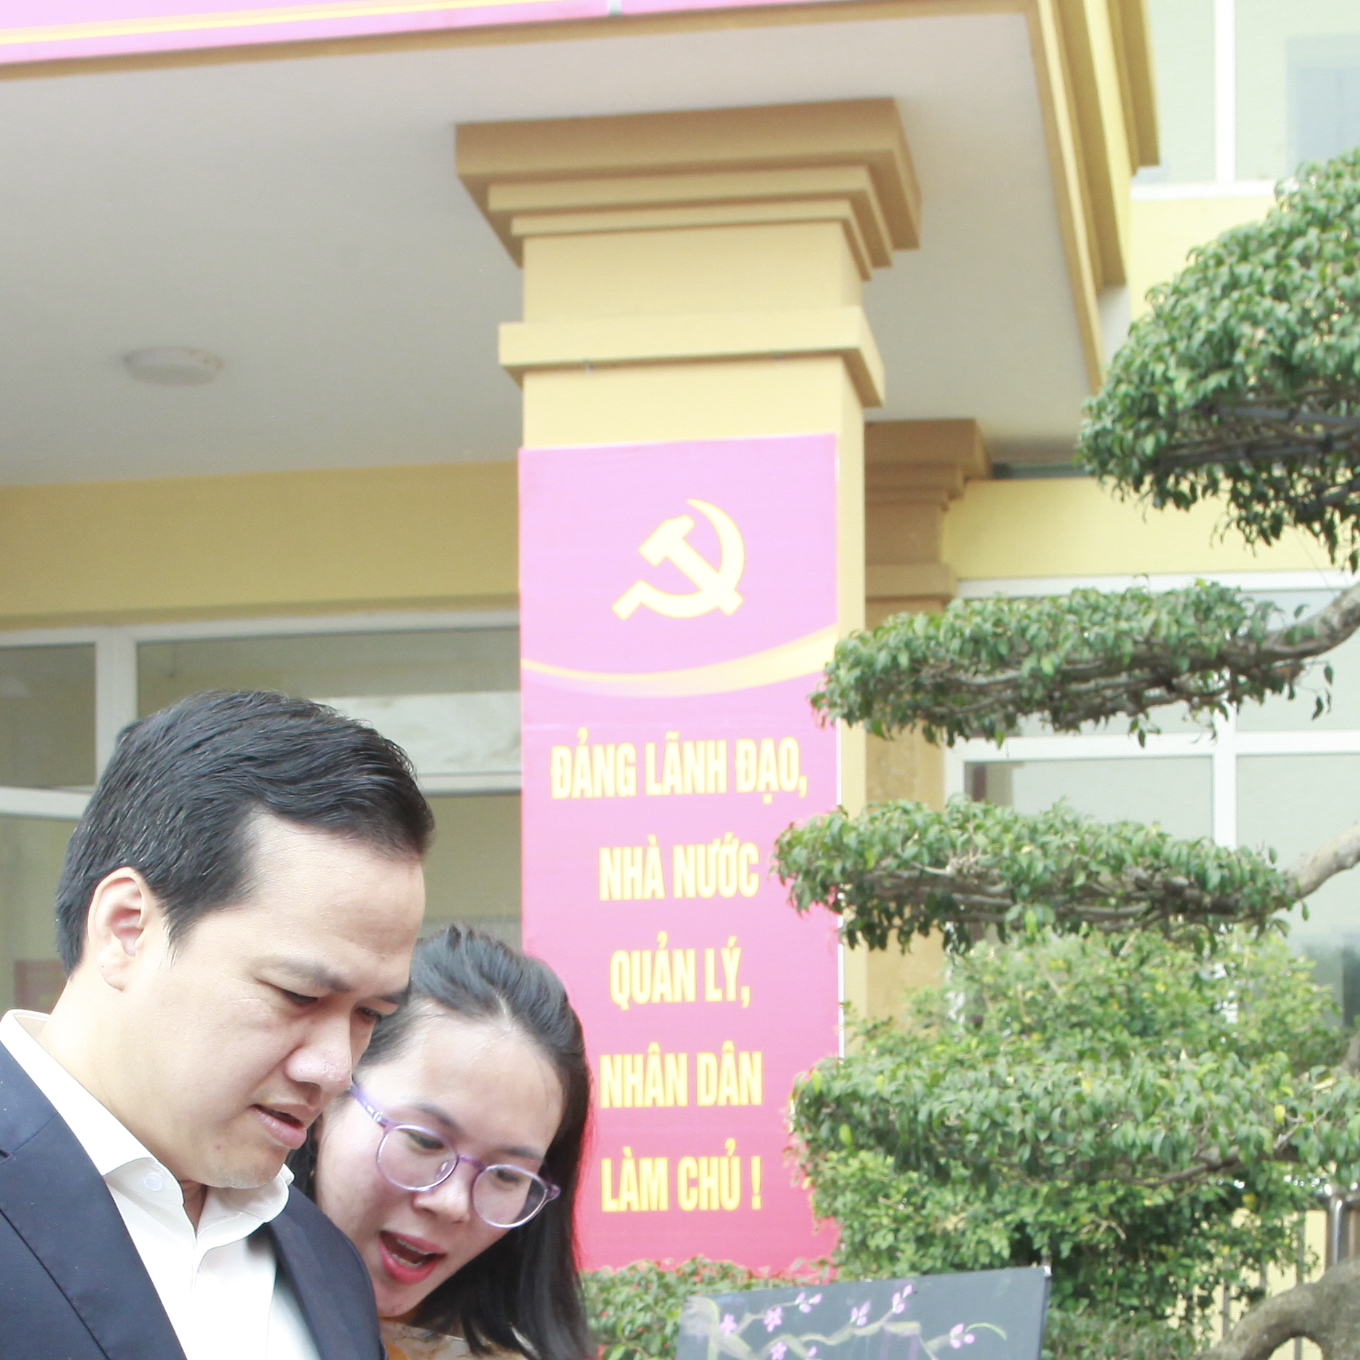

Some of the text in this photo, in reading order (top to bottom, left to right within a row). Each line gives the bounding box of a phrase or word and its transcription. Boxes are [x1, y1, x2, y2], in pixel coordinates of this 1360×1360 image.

[549, 725, 809, 805] ĐẢNG LÃNH ĐẠO,
[598, 831, 760, 902] NHÀ NƯỚC
[608, 930, 751, 1011] QUẢN LÝ,
[599, 1039, 763, 1109] NHÂN DÂN
[601, 1136, 762, 1213] LÀM CHỦ !
